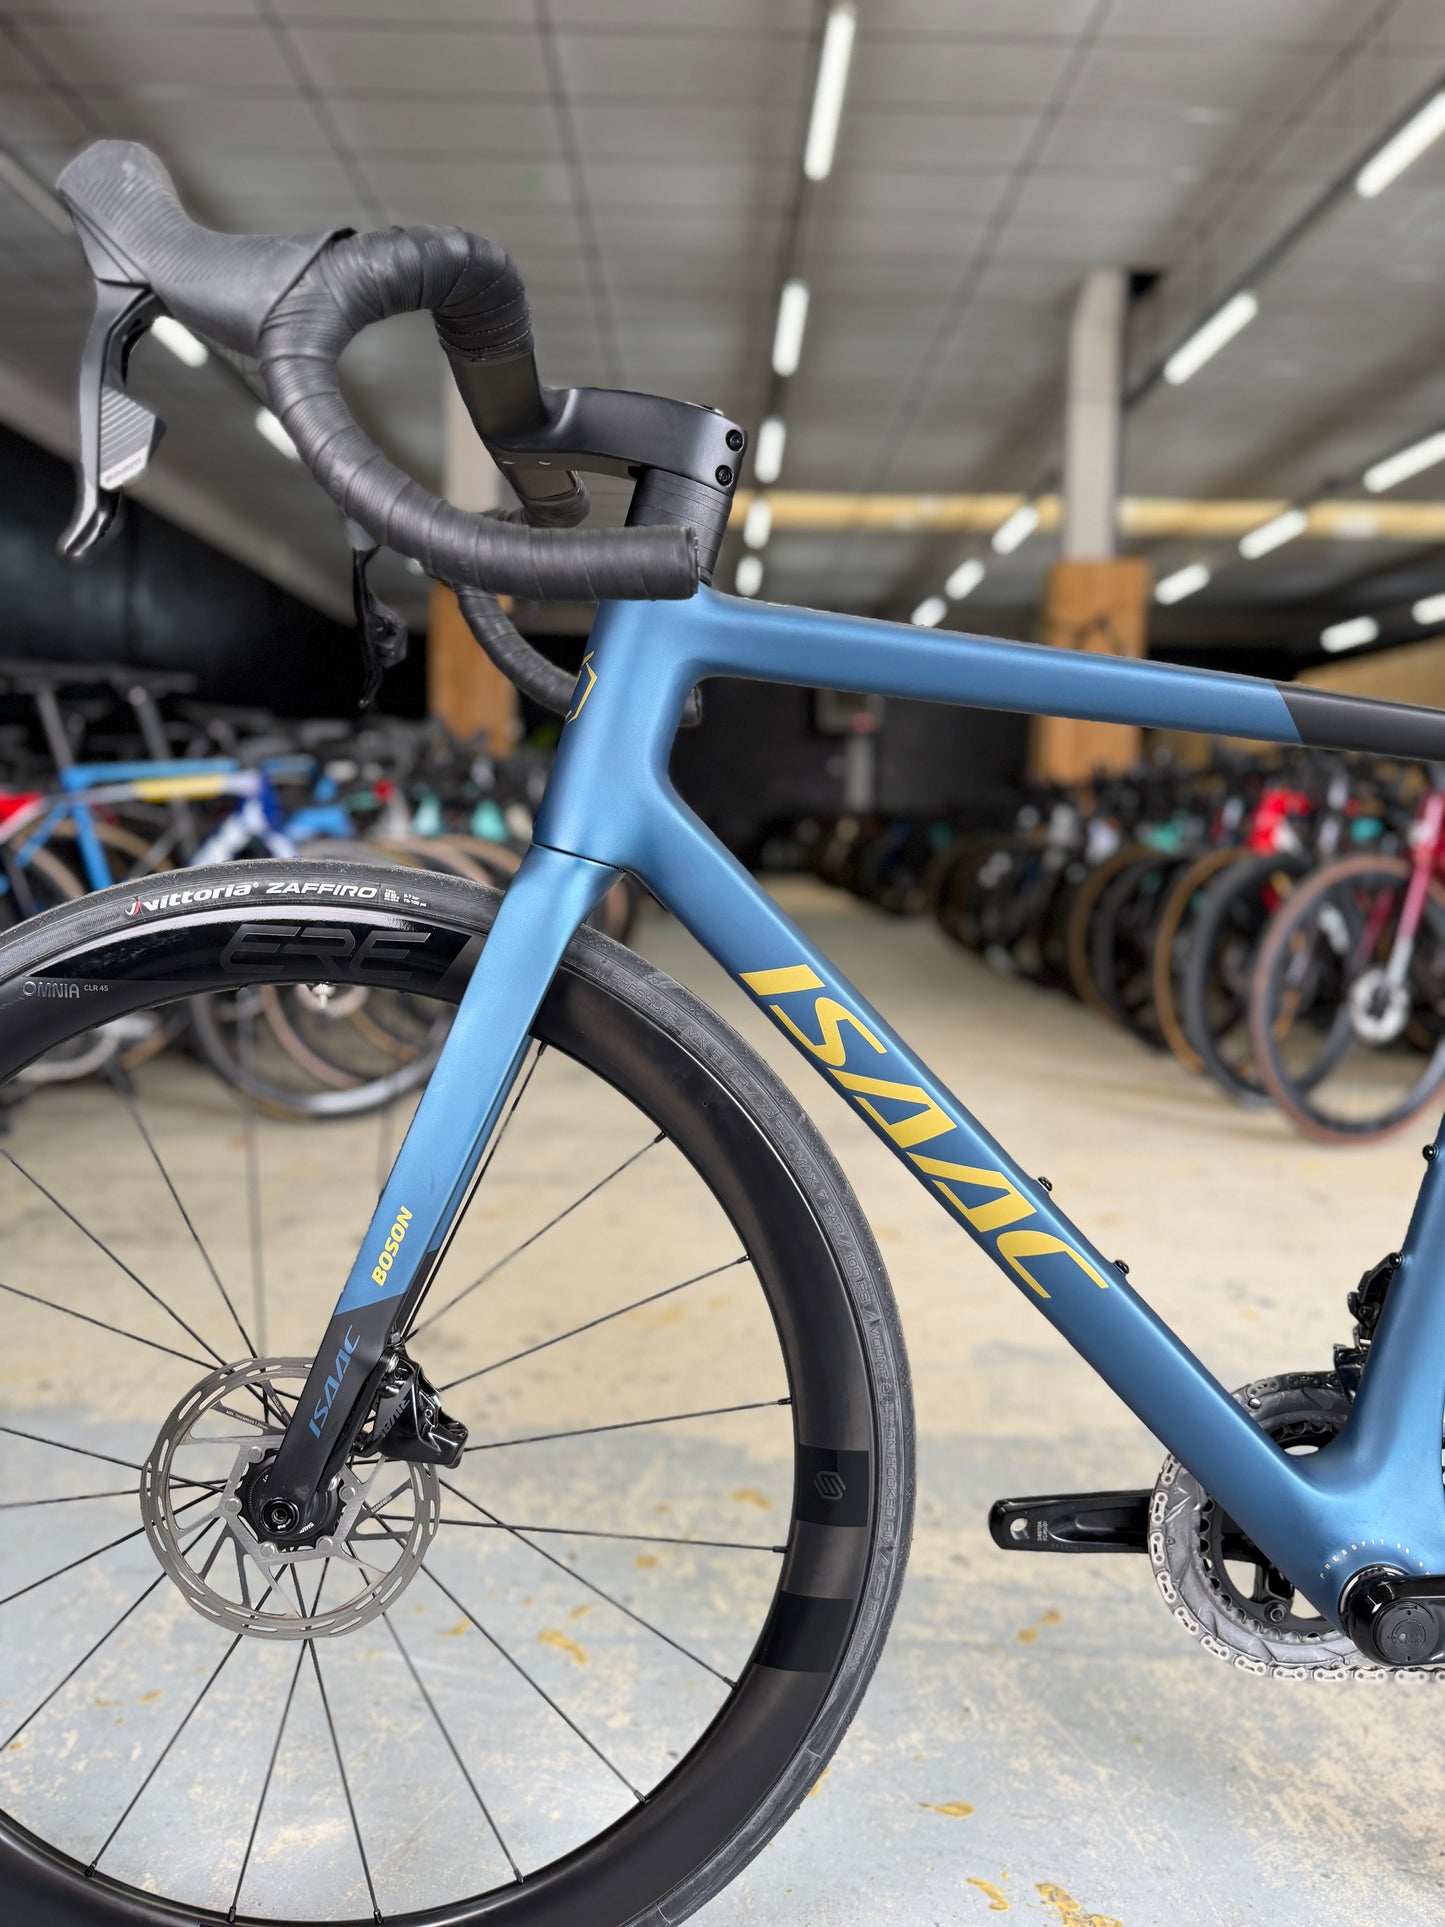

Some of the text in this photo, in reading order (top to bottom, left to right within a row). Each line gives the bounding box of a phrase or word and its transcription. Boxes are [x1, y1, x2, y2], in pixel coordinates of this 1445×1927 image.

[265, 881, 378, 899] ZAFFIRO
[218, 923, 432, 981] ERE
[22, 980, 109, 999] OMNIA CLR 45
[738, 963, 1110, 1299] ISAAC
[371, 1205, 414, 1287] BOSON
[308, 1324, 361, 1439] ISAAC
[1319, 1538, 1386, 1580] PRESSFIT
